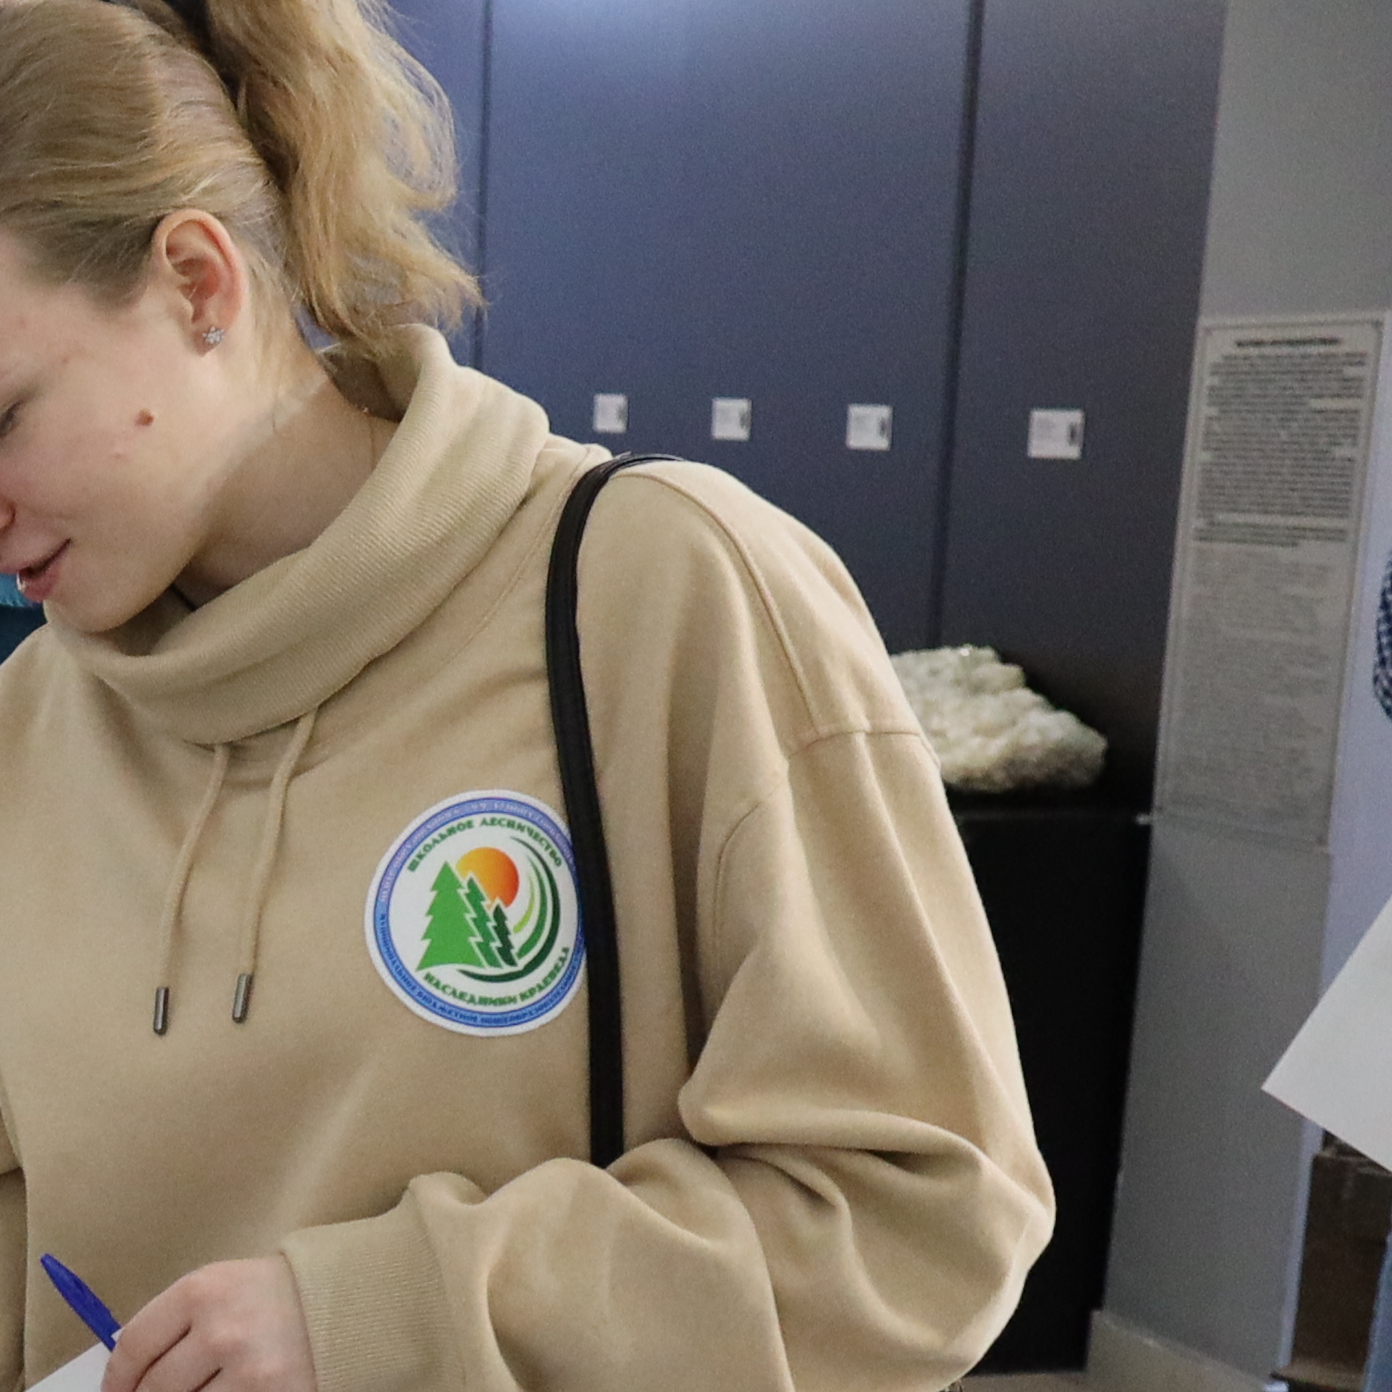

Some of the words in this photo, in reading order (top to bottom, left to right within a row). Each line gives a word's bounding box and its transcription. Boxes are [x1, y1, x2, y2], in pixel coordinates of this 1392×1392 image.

[407, 819, 474, 872] ШКОЛЬНОЕ
[480, 816, 562, 868] ЛЕСНИЧЕСТВО
[423, 972, 517, 1007] НАСЛЕДНИКИ
[519, 946, 570, 1002] КРАЕВЕДА
